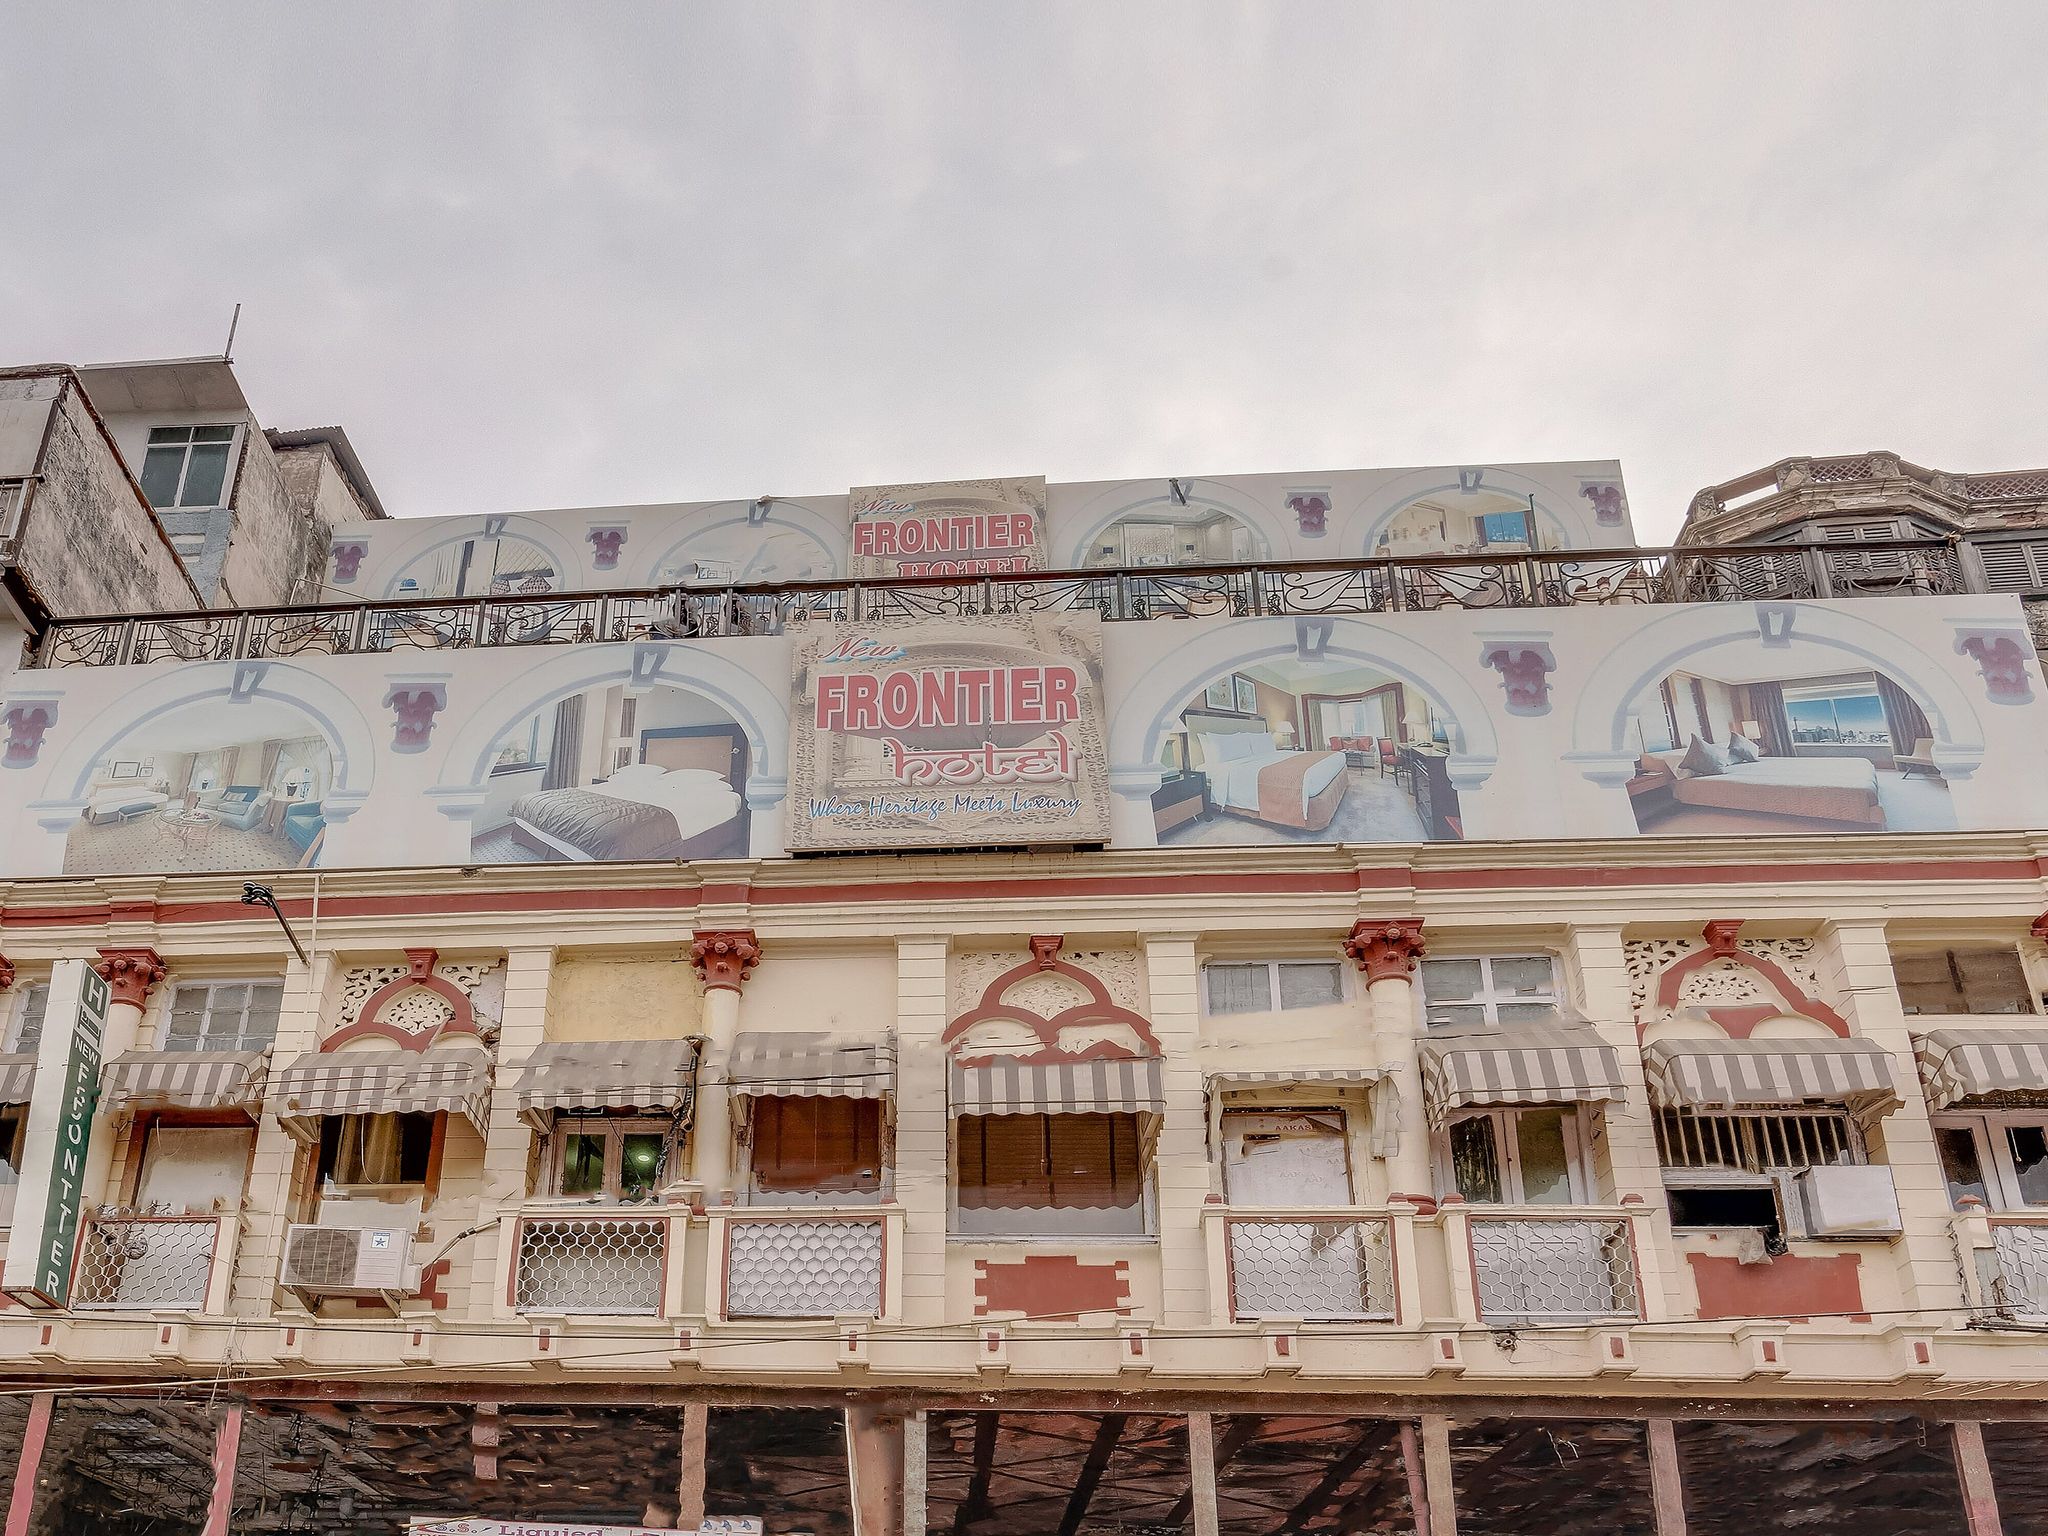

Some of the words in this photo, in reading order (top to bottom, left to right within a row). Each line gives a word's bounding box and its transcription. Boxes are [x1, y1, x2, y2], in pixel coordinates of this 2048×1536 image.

[859, 499, 911, 513] New
[853, 513, 1036, 557] FRONTIER
[819, 636, 899, 660] New
[814, 666, 1081, 731] FRONTIER
[882, 730, 1083, 788] hotel
[808, 796, 864, 819] Where
[870, 795, 948, 821] Heritage
[953, 793, 1006, 815] Meets
[1011, 791, 1083, 818] Luxury
[87, 976, 104, 1012] H
[74, 1038, 99, 1067] NEW
